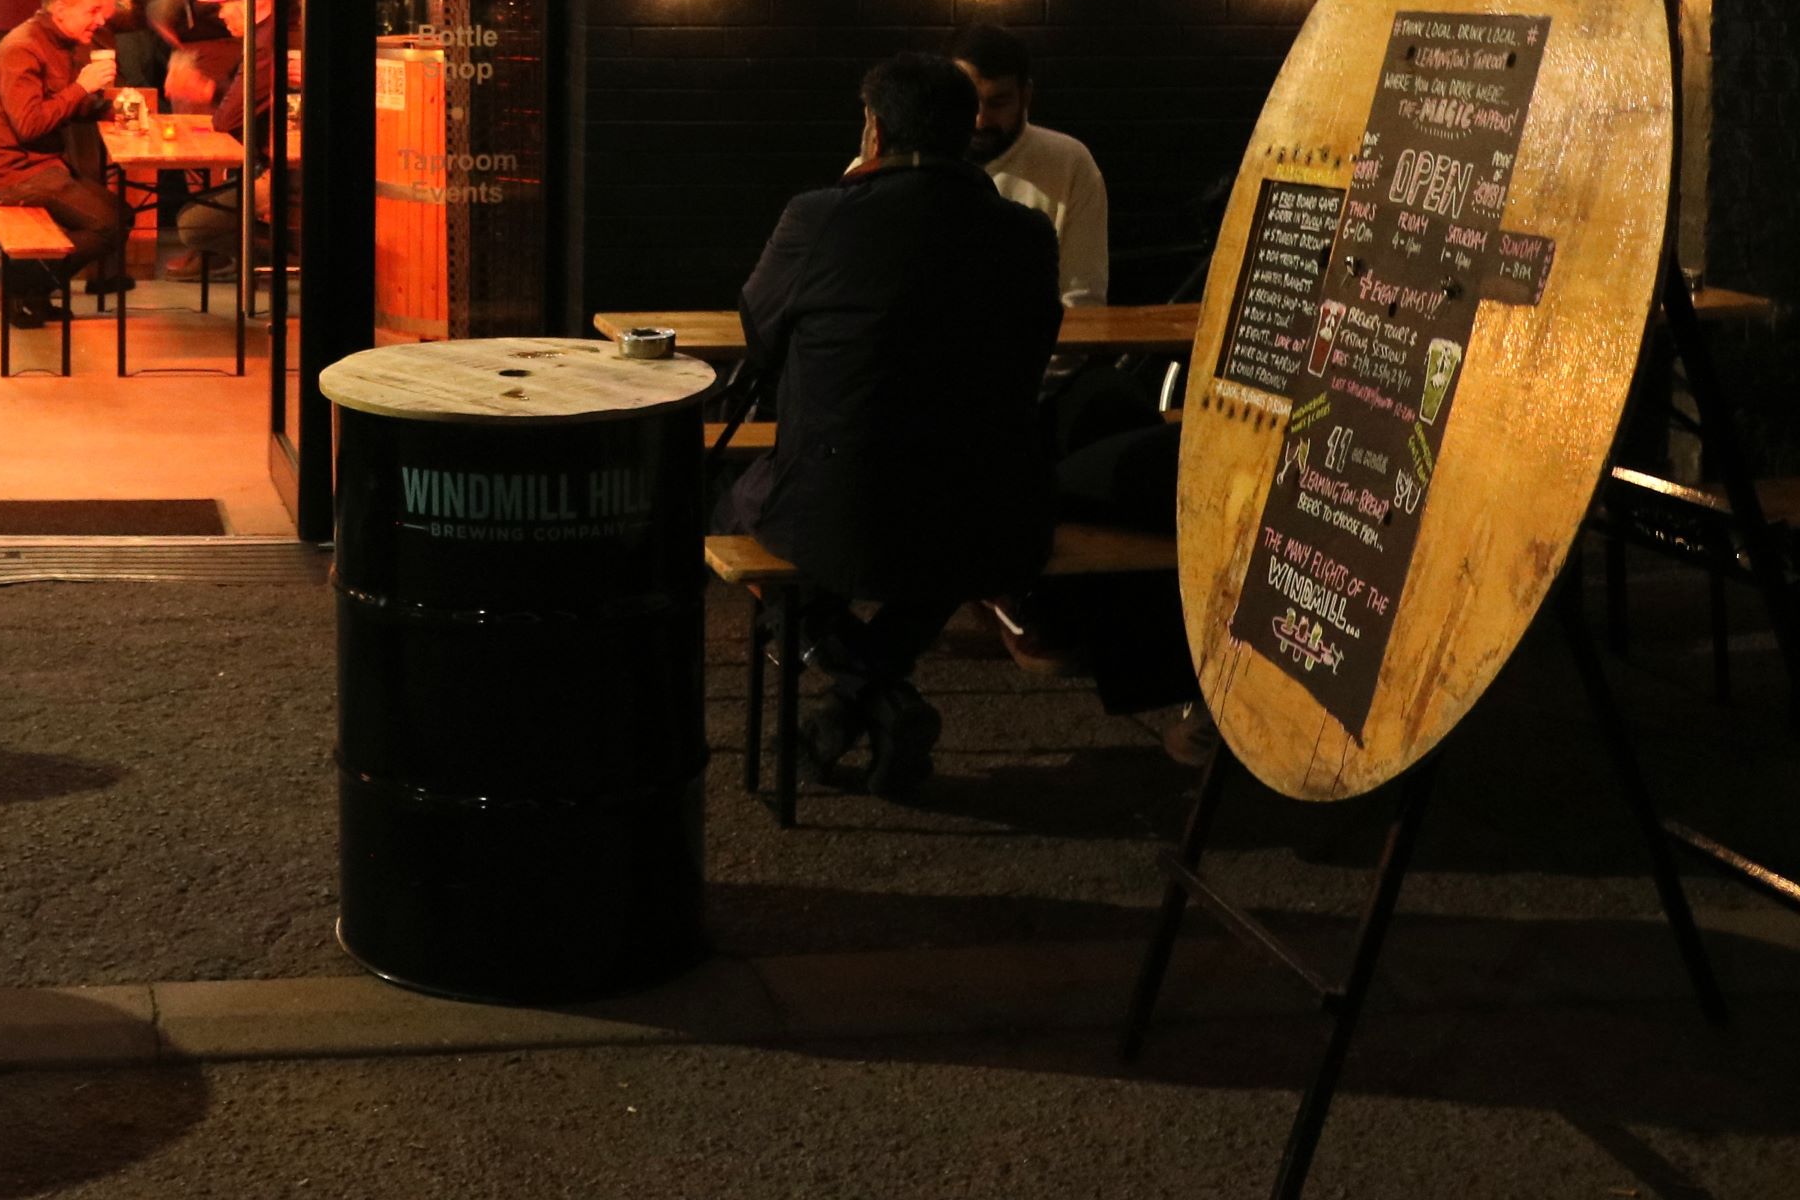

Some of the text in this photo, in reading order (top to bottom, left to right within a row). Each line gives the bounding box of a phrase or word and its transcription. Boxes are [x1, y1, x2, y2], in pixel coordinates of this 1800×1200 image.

[418, 24, 499, 48] Bottle
[423, 57, 494, 85] Shop
[399, 148, 518, 174] Taproom
[411, 181, 504, 204] Events
[1388, 148, 1475, 220] OPEN
[1348, 200, 1543, 262] THURS FRIDAY SATURDAY SUNDAY
[401, 465, 654, 521] WINDMILL HILL
[1296, 490, 1323, 518] BEERS
[430, 521, 626, 542] BREWING COMPANY
[1264, 526, 1390, 617] THE MANY FLIGHTS OF THE
